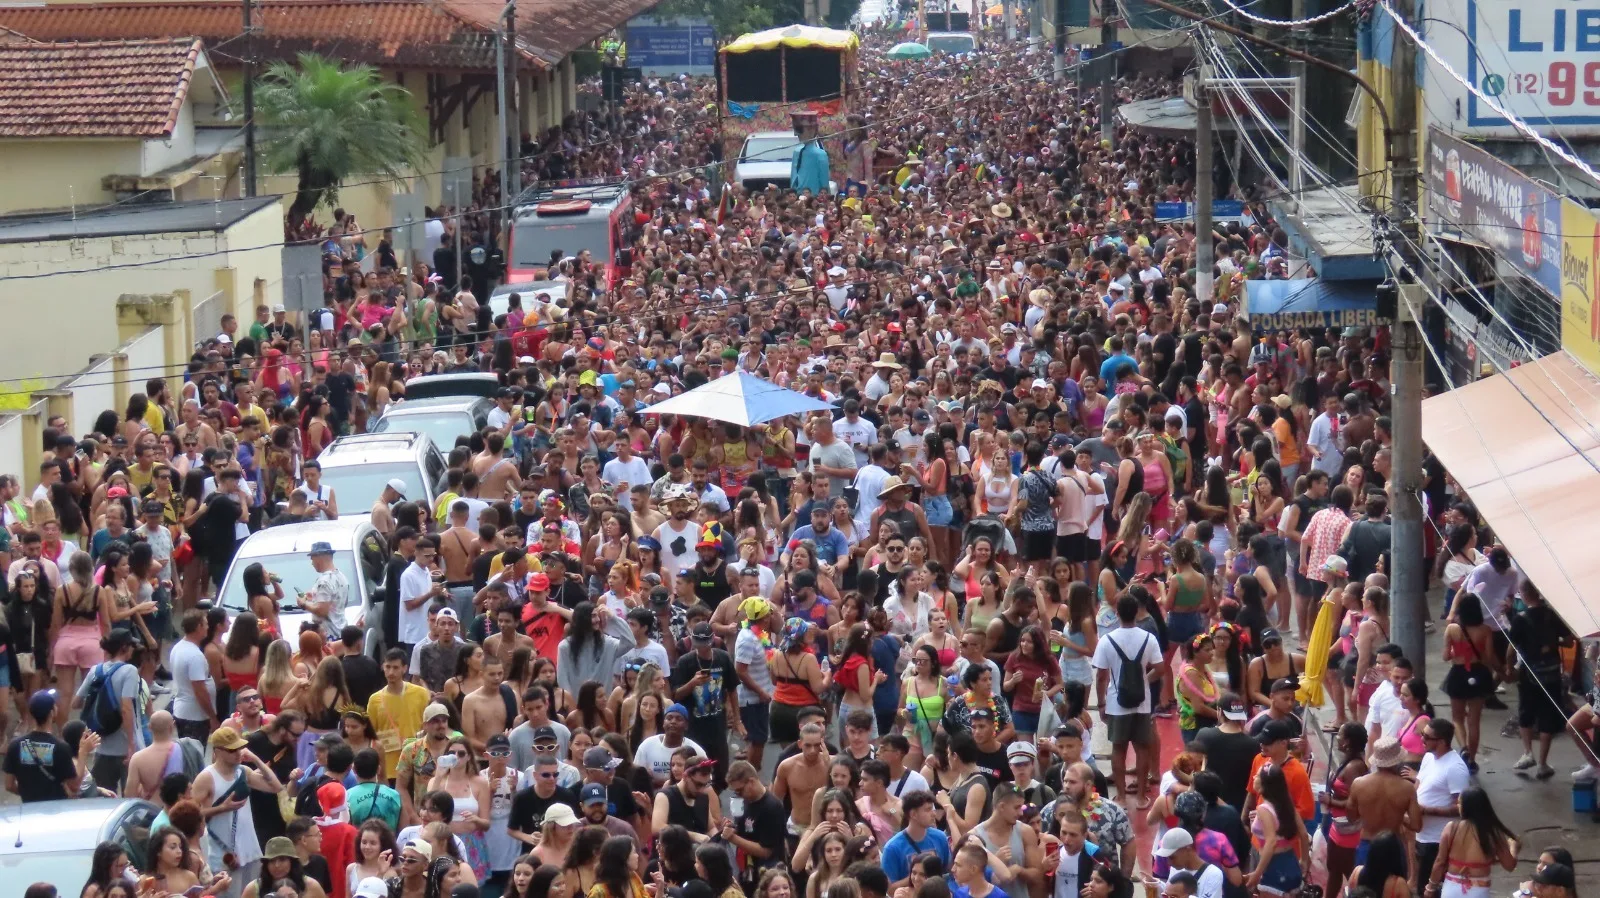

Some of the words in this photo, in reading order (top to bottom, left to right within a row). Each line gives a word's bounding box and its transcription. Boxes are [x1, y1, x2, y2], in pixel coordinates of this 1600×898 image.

[1508, 72, 1544, 95] (12)
[1563, 241, 1590, 292] Biovet
[1251, 310, 1326, 331] POUSADA
[1330, 308, 1391, 327] LIBER
